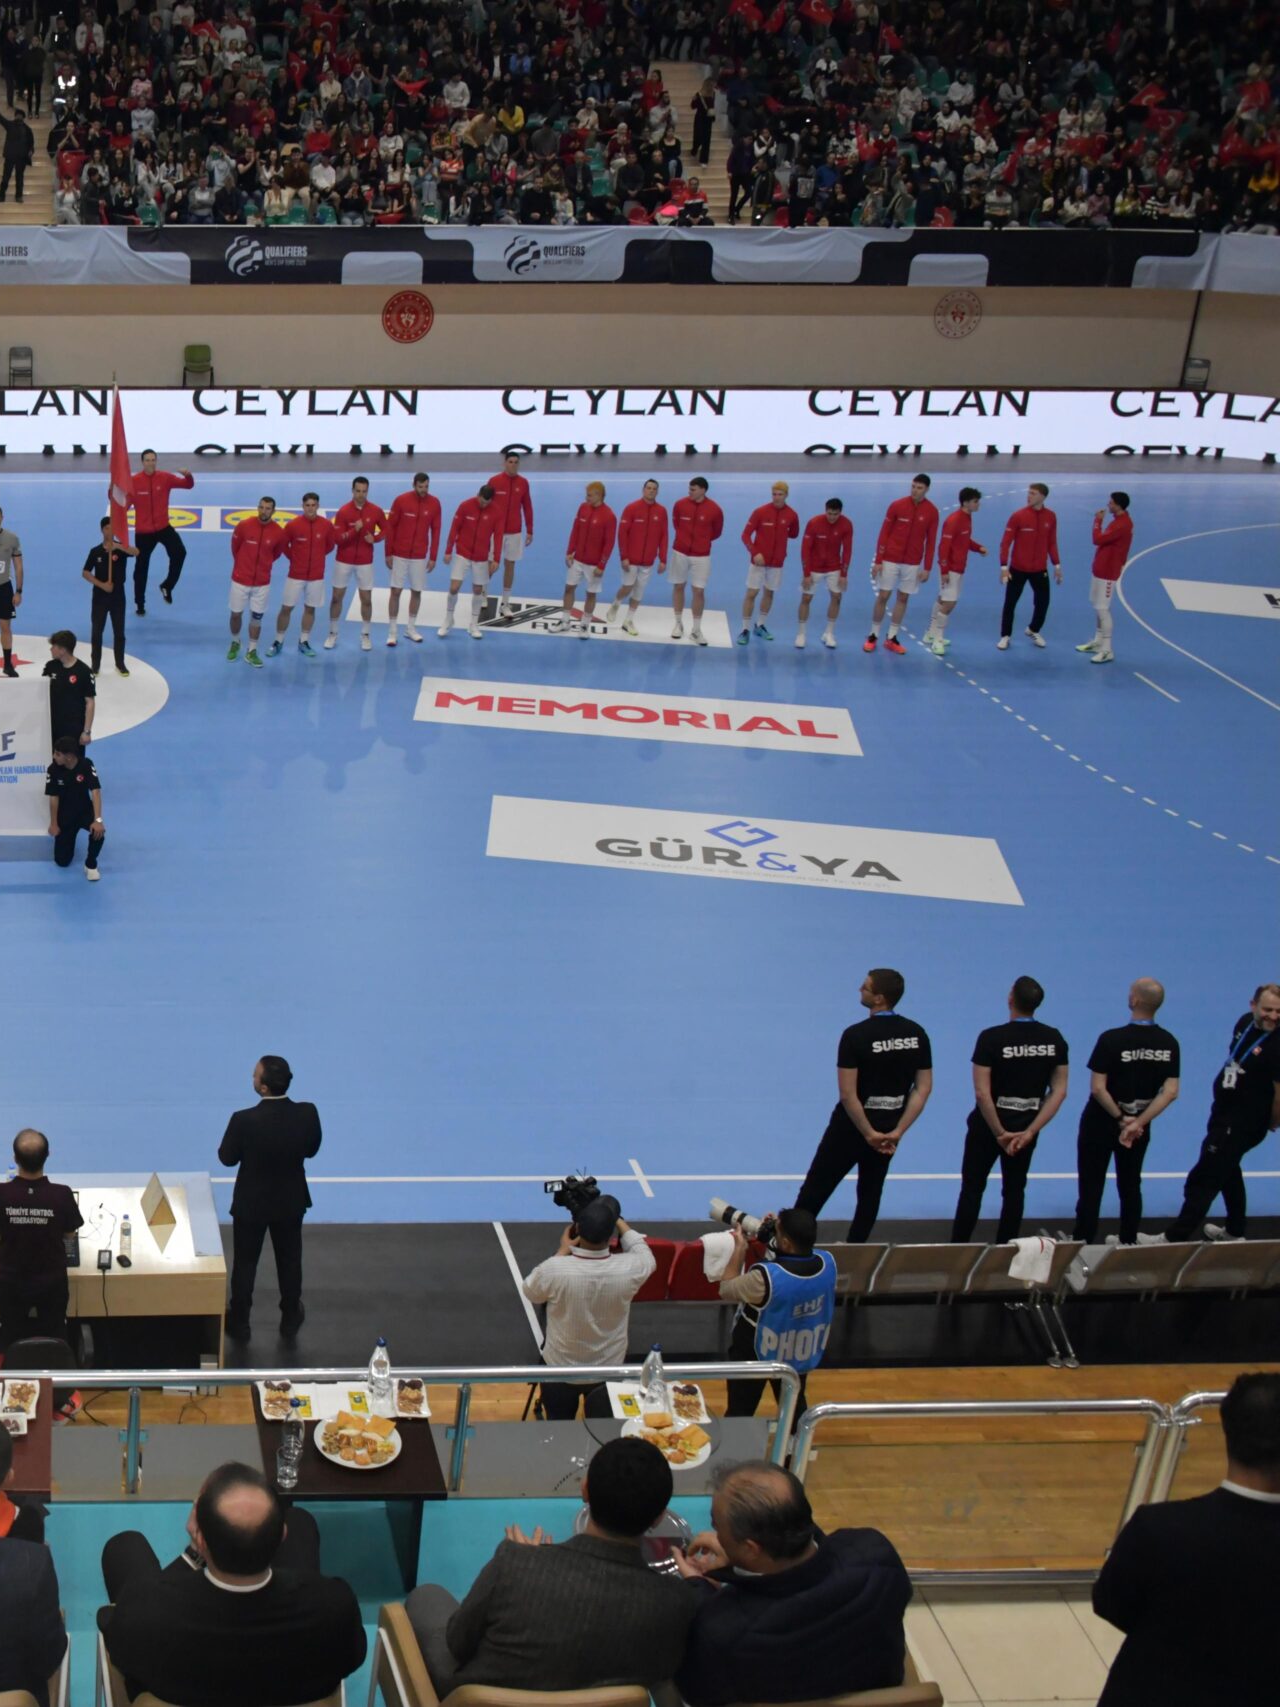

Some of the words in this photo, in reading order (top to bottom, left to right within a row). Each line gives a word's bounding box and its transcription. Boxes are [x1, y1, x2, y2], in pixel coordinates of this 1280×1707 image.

[265, 246, 308, 259] QUALIFIERS
[543, 246, 586, 258] QUALIFIERS
[192, 389, 418, 416] CEYLAN
[501, 389, 726, 416] CEYLAN
[807, 390, 1030, 417] CEYLAN
[434, 691, 839, 739] MEMORIAL
[14, 765, 46, 774] HANDBALL
[594, 836, 902, 882] GÜR&YA
[5, 1206, 29, 1216] TÜRKİYE
[30, 1208, 54, 1217] HENTBOL
[10, 1217, 48, 1225] FEDERASYONU
